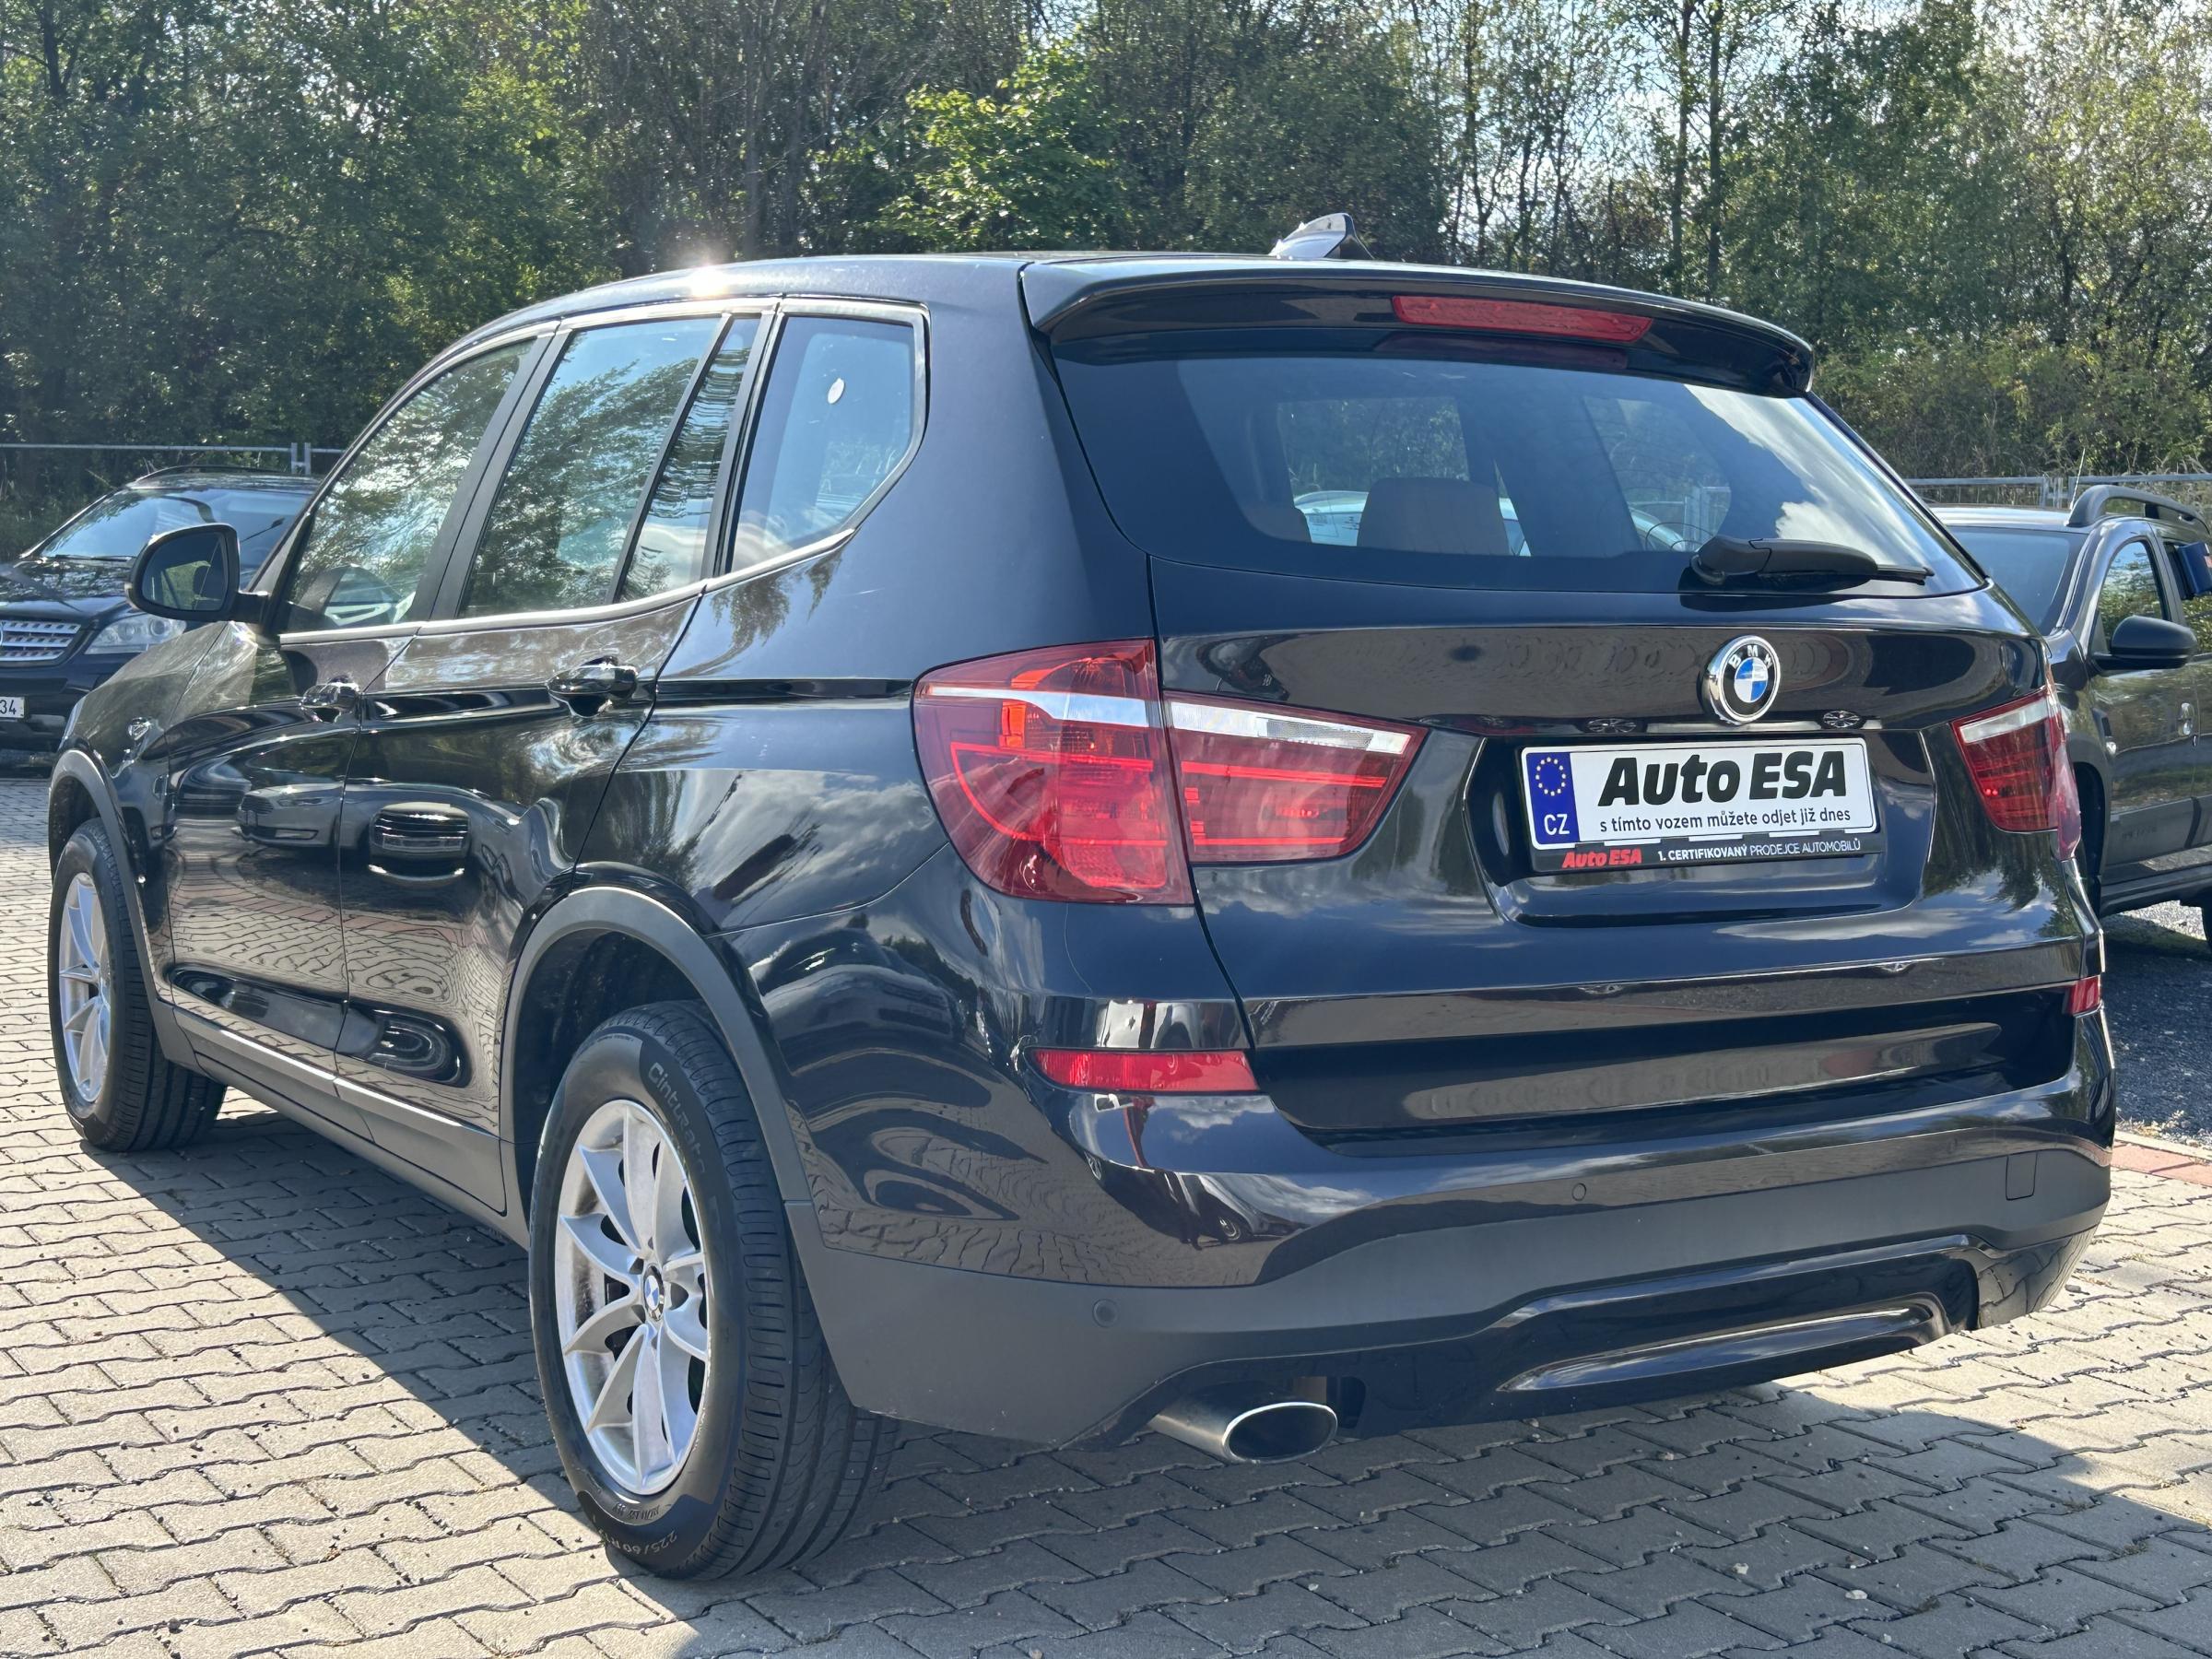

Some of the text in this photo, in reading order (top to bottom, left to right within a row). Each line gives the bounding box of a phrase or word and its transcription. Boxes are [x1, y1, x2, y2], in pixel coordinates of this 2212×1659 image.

[1728, 644, 1772, 669] BMW
[1597, 750, 1846, 806] Auto ESA
[1544, 813, 1571, 835] CZ
[1600, 806, 1851, 832] s tímto vozem můžete odjet již dnes
[1561, 848, 1642, 868] Auto ESA
[1658, 837, 1861, 862] 1. CERTIFIKOVANÝ PRODEJCE AUTOMOBILŮ
